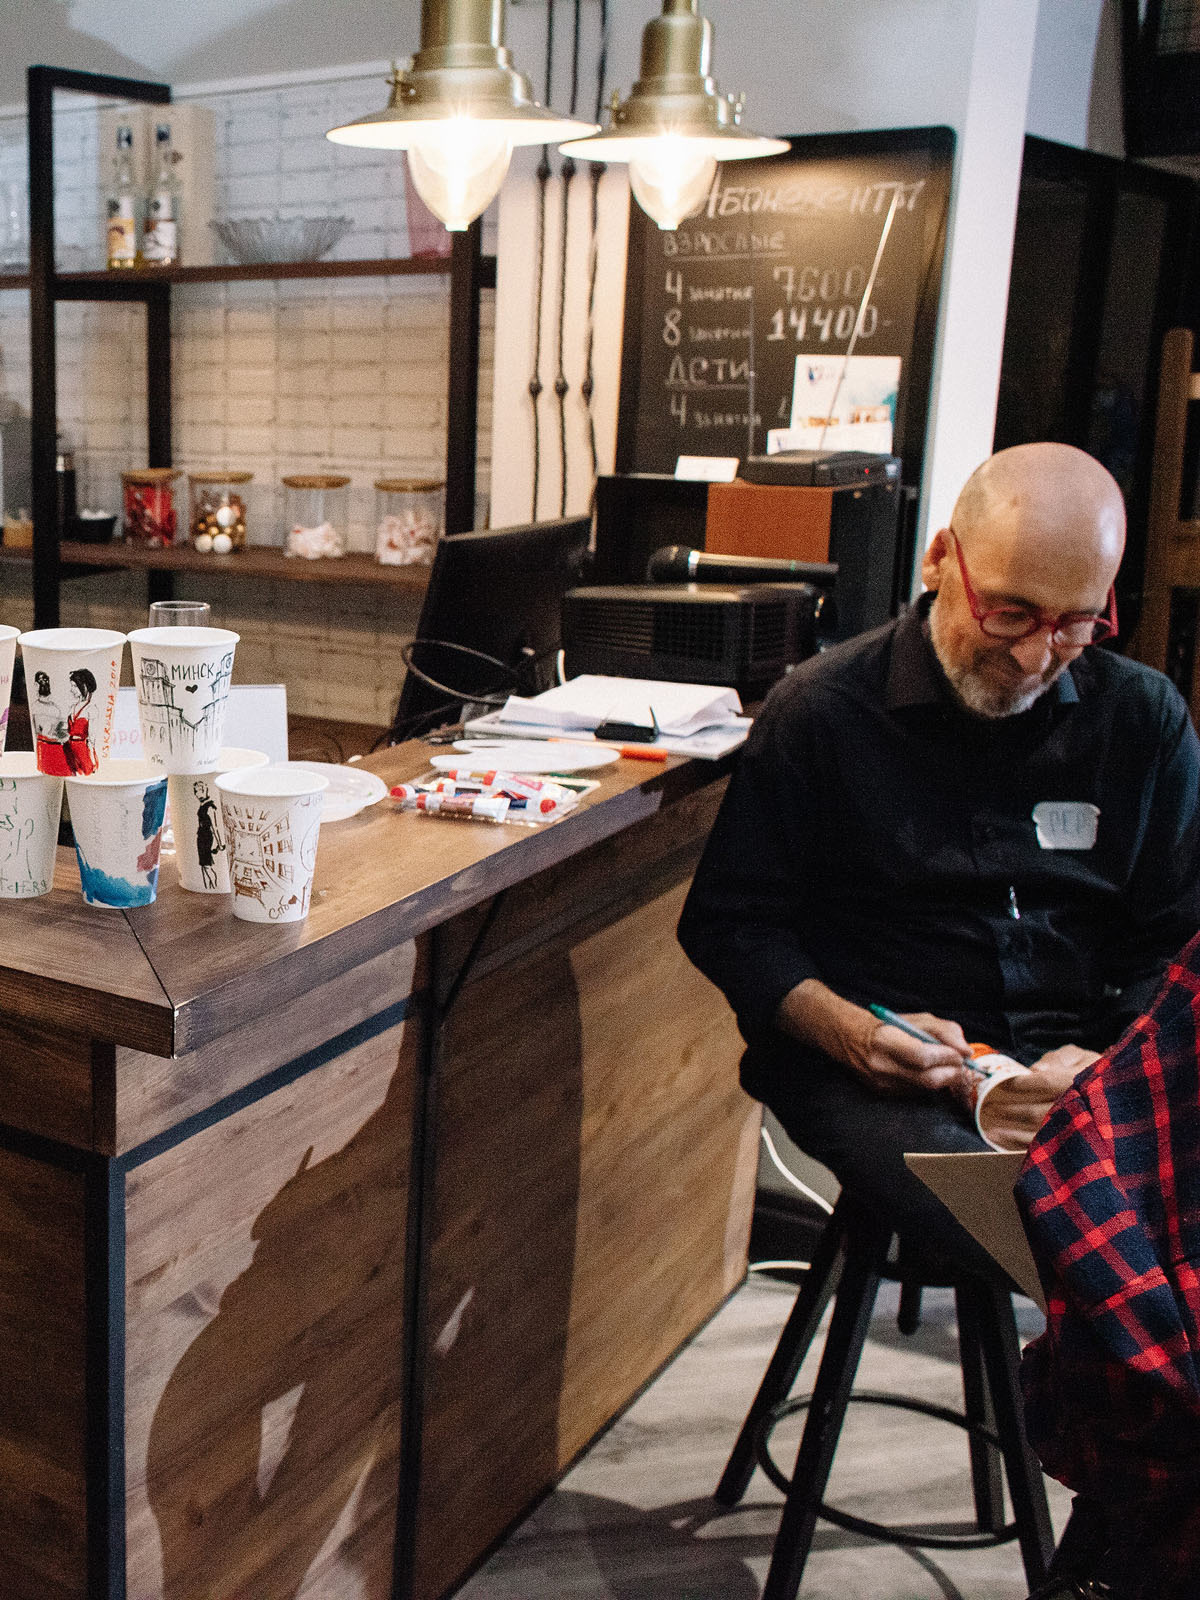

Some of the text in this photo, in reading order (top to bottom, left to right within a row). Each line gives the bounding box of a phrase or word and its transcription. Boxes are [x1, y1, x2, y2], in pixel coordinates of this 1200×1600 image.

[665, 269, 682, 304] 4
[663, 307, 681, 346] 8
[669, 393, 687, 427] 4
[171, 662, 215, 681] МИНСК
